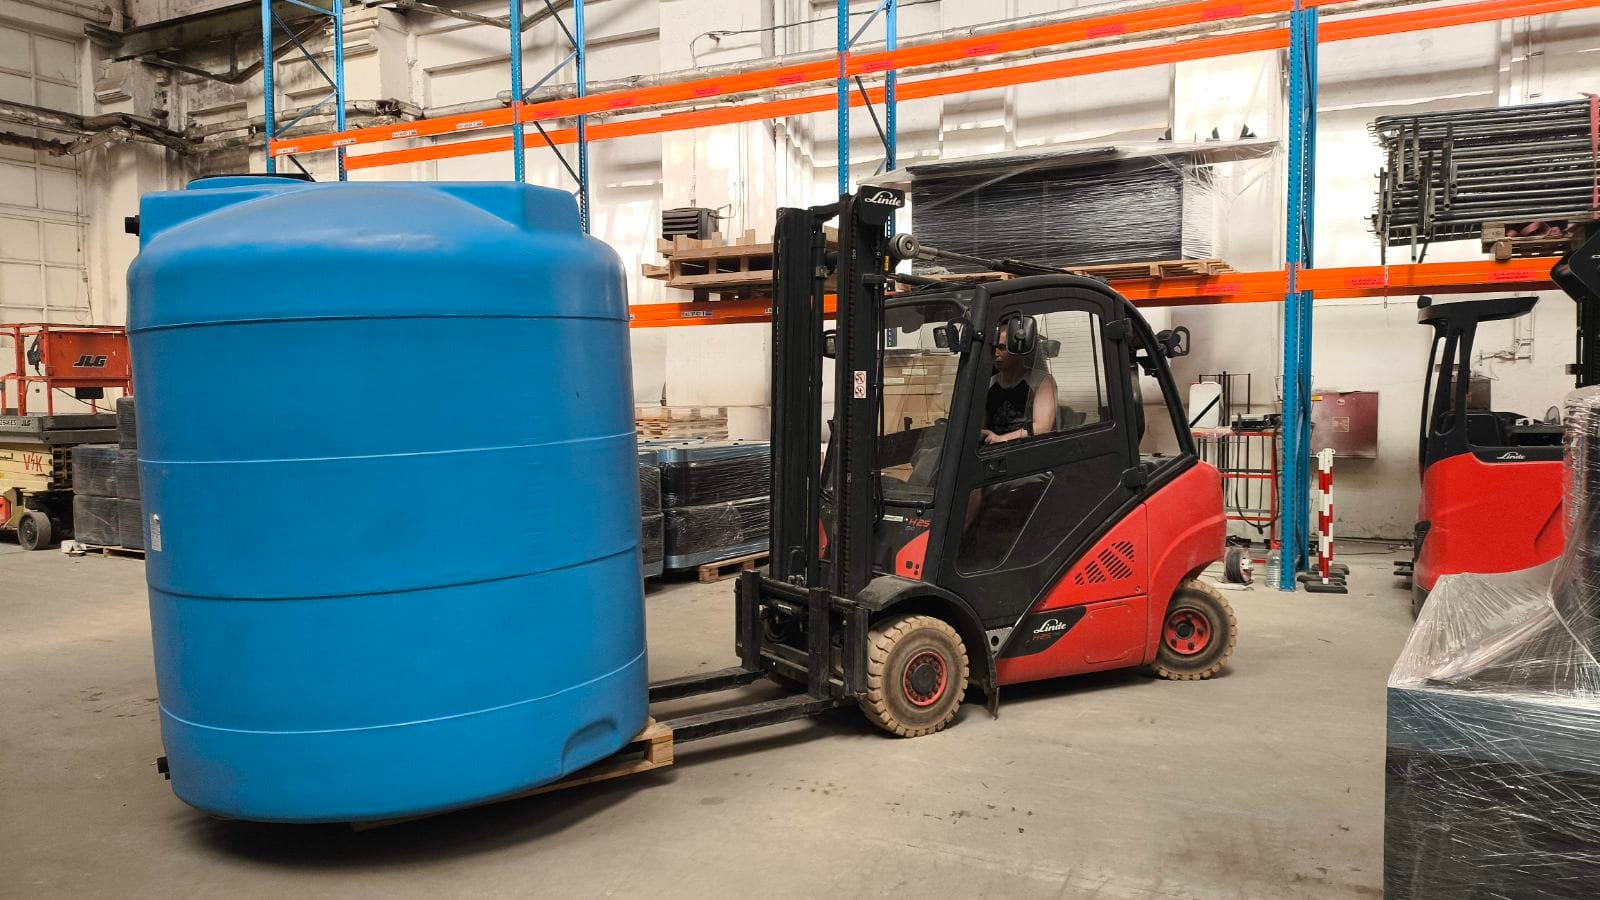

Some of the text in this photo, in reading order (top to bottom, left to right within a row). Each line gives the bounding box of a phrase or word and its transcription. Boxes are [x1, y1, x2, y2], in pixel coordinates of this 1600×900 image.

[864, 190, 902, 207] Linde
[73, 355, 108, 368] JLG
[1496, 451, 1526, 460] Linde
[1033, 618, 1067, 634] Linde
